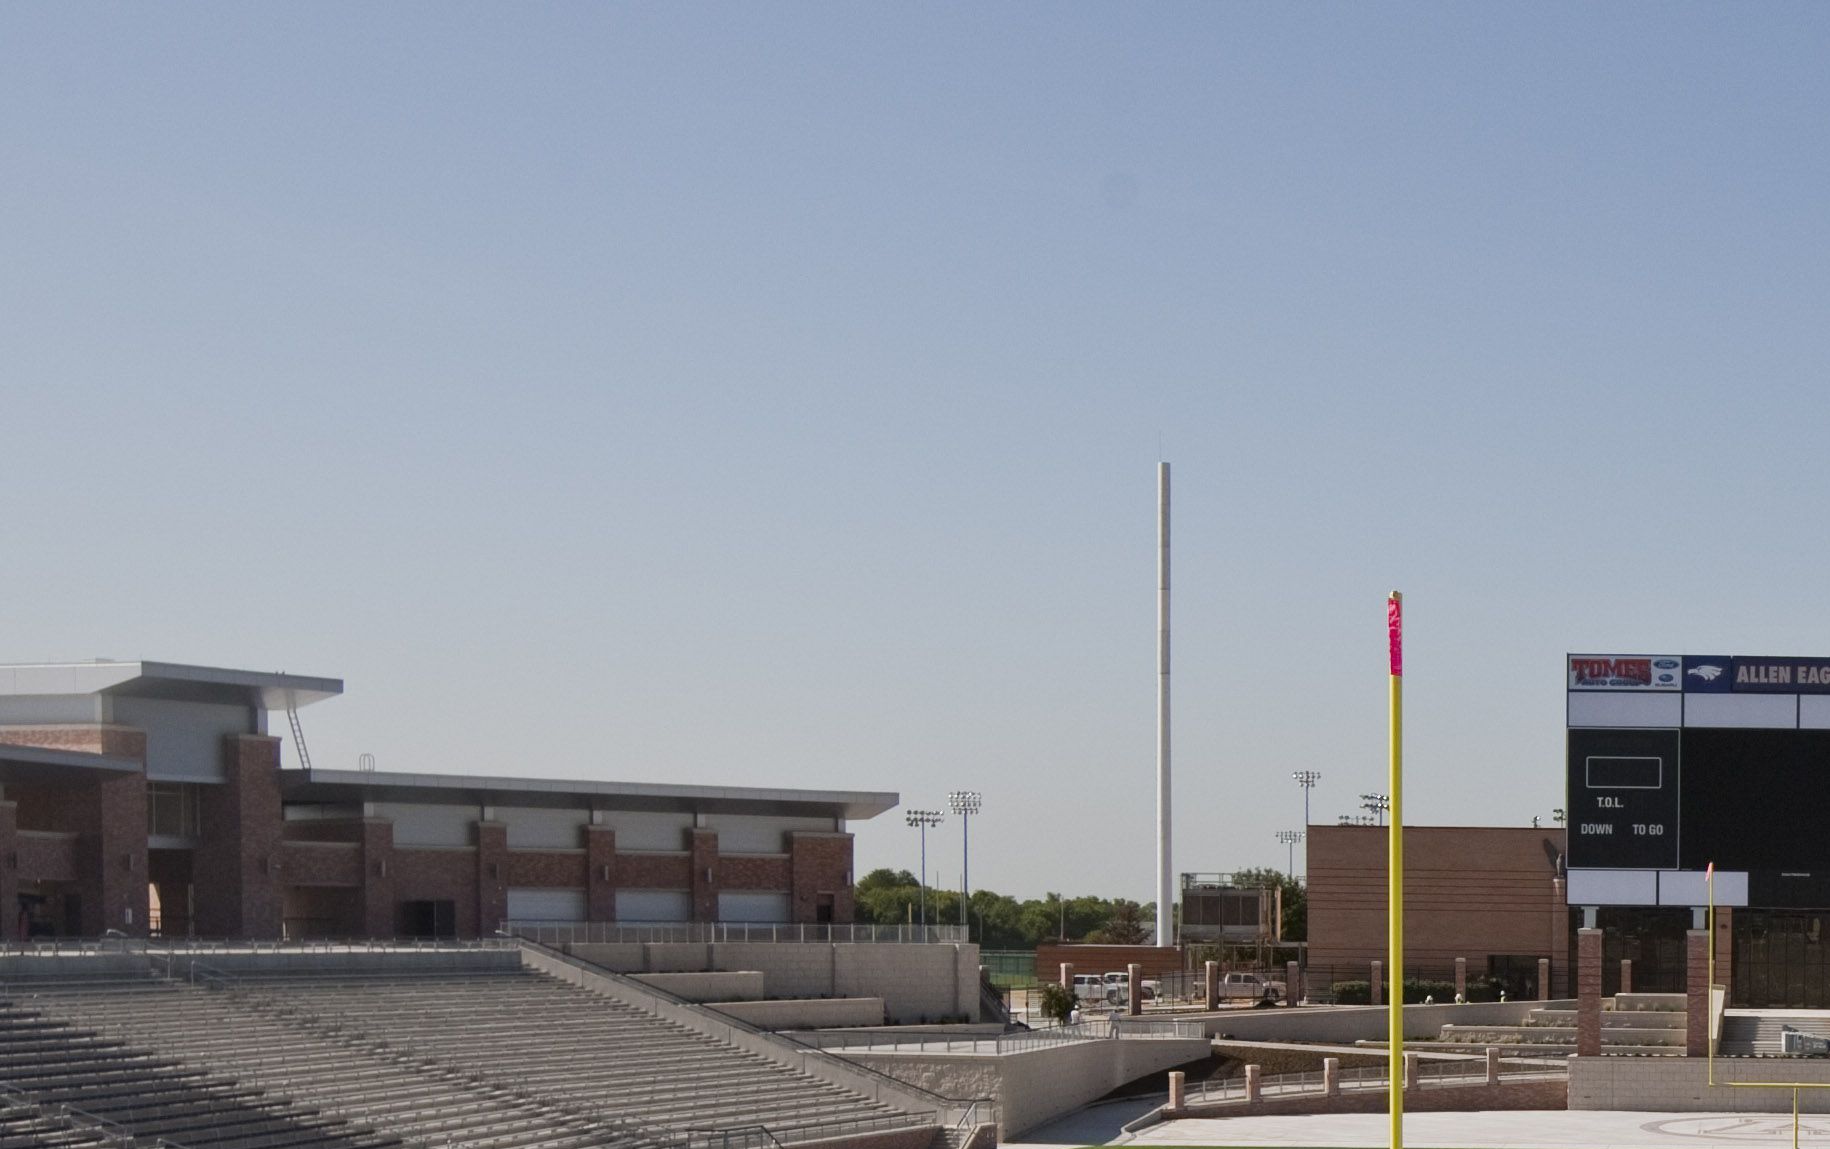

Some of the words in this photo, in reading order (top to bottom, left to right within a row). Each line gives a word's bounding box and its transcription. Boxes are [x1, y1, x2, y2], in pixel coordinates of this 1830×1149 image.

[1737, 665, 1790, 683] ALLEN
[1597, 797, 1624, 808] T.O.L.
[1581, 824, 1613, 834] DOWN
[1632, 824, 1646, 835] TO
[1649, 825, 1664, 835] GO
